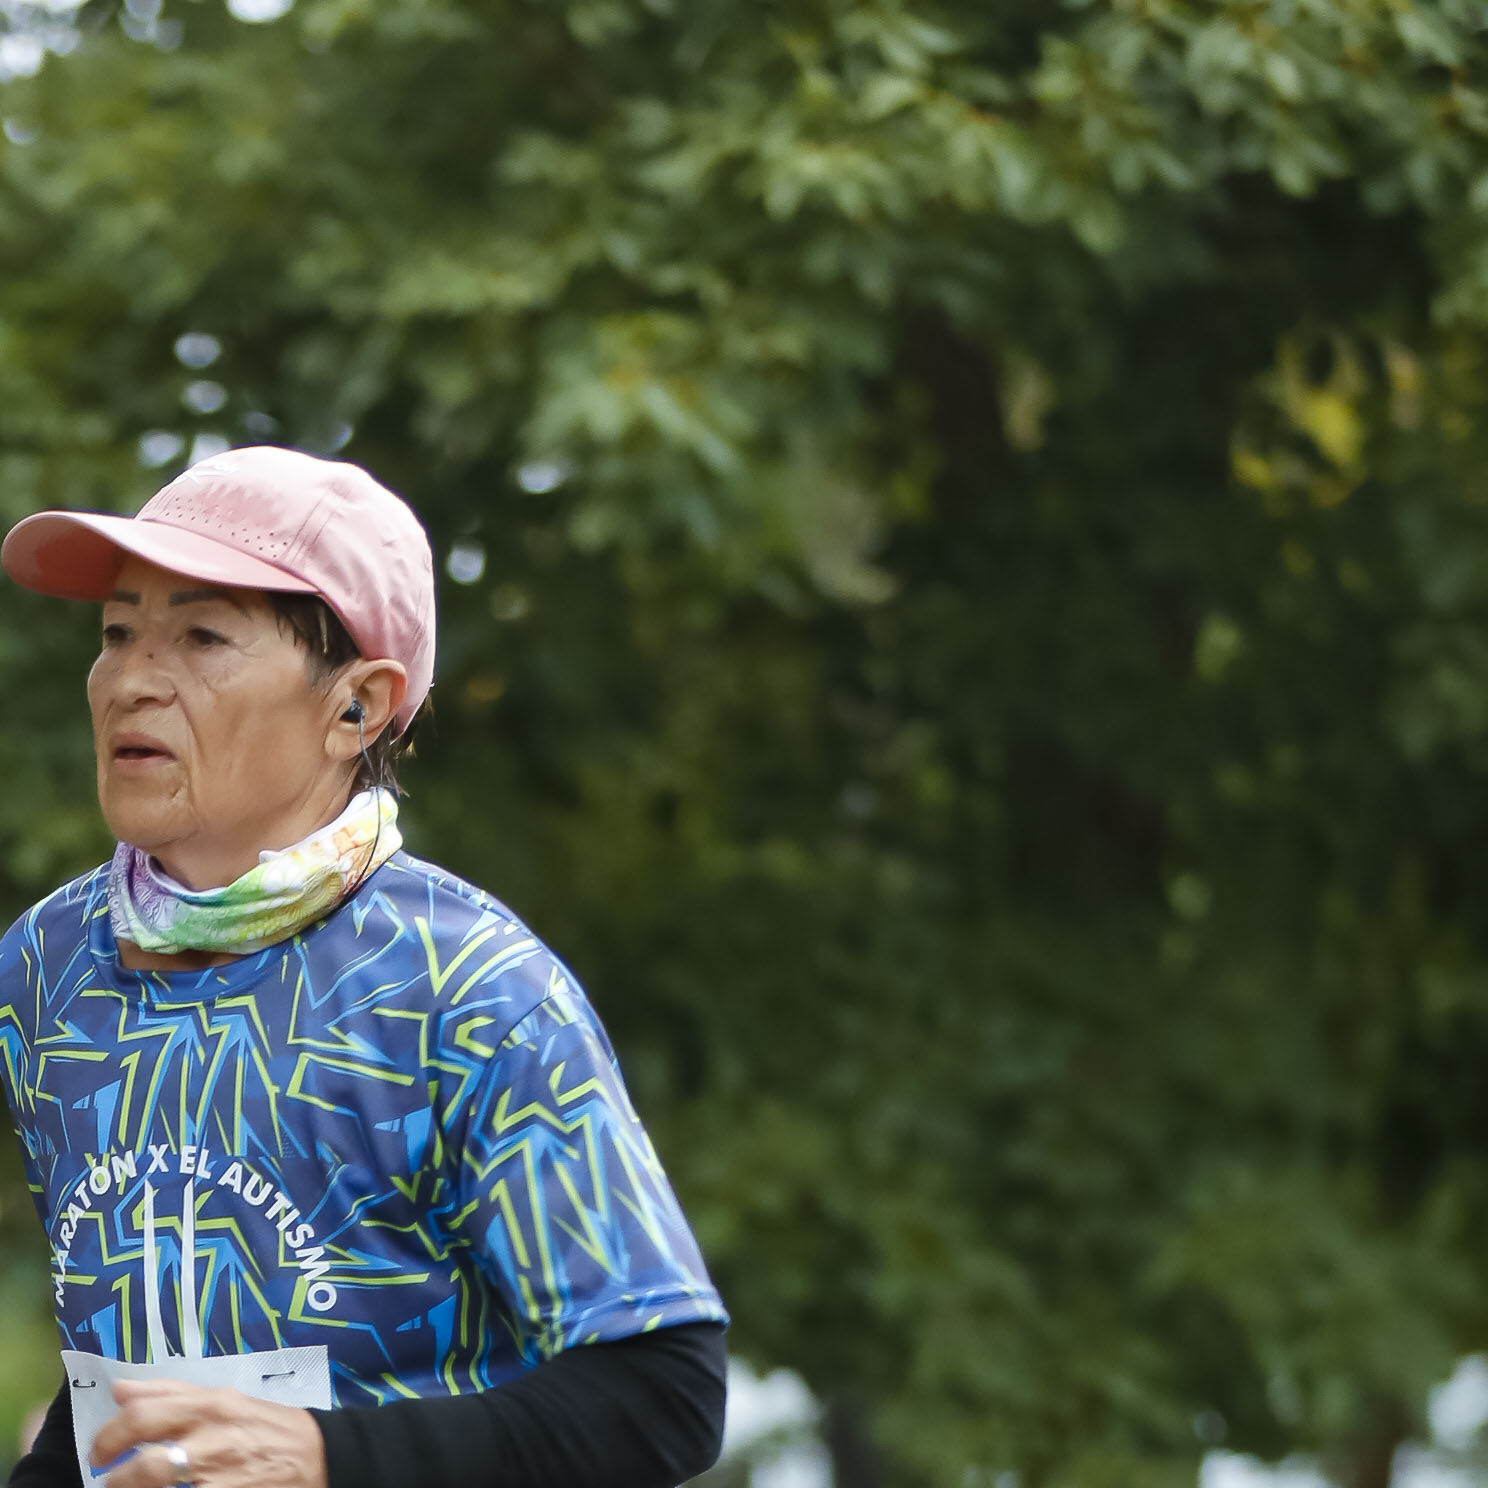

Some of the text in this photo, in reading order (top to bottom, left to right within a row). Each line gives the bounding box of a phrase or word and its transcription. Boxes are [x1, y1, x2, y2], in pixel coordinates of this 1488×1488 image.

[55, 1143, 338, 1312] MARATÓN X EL AUTISMO
